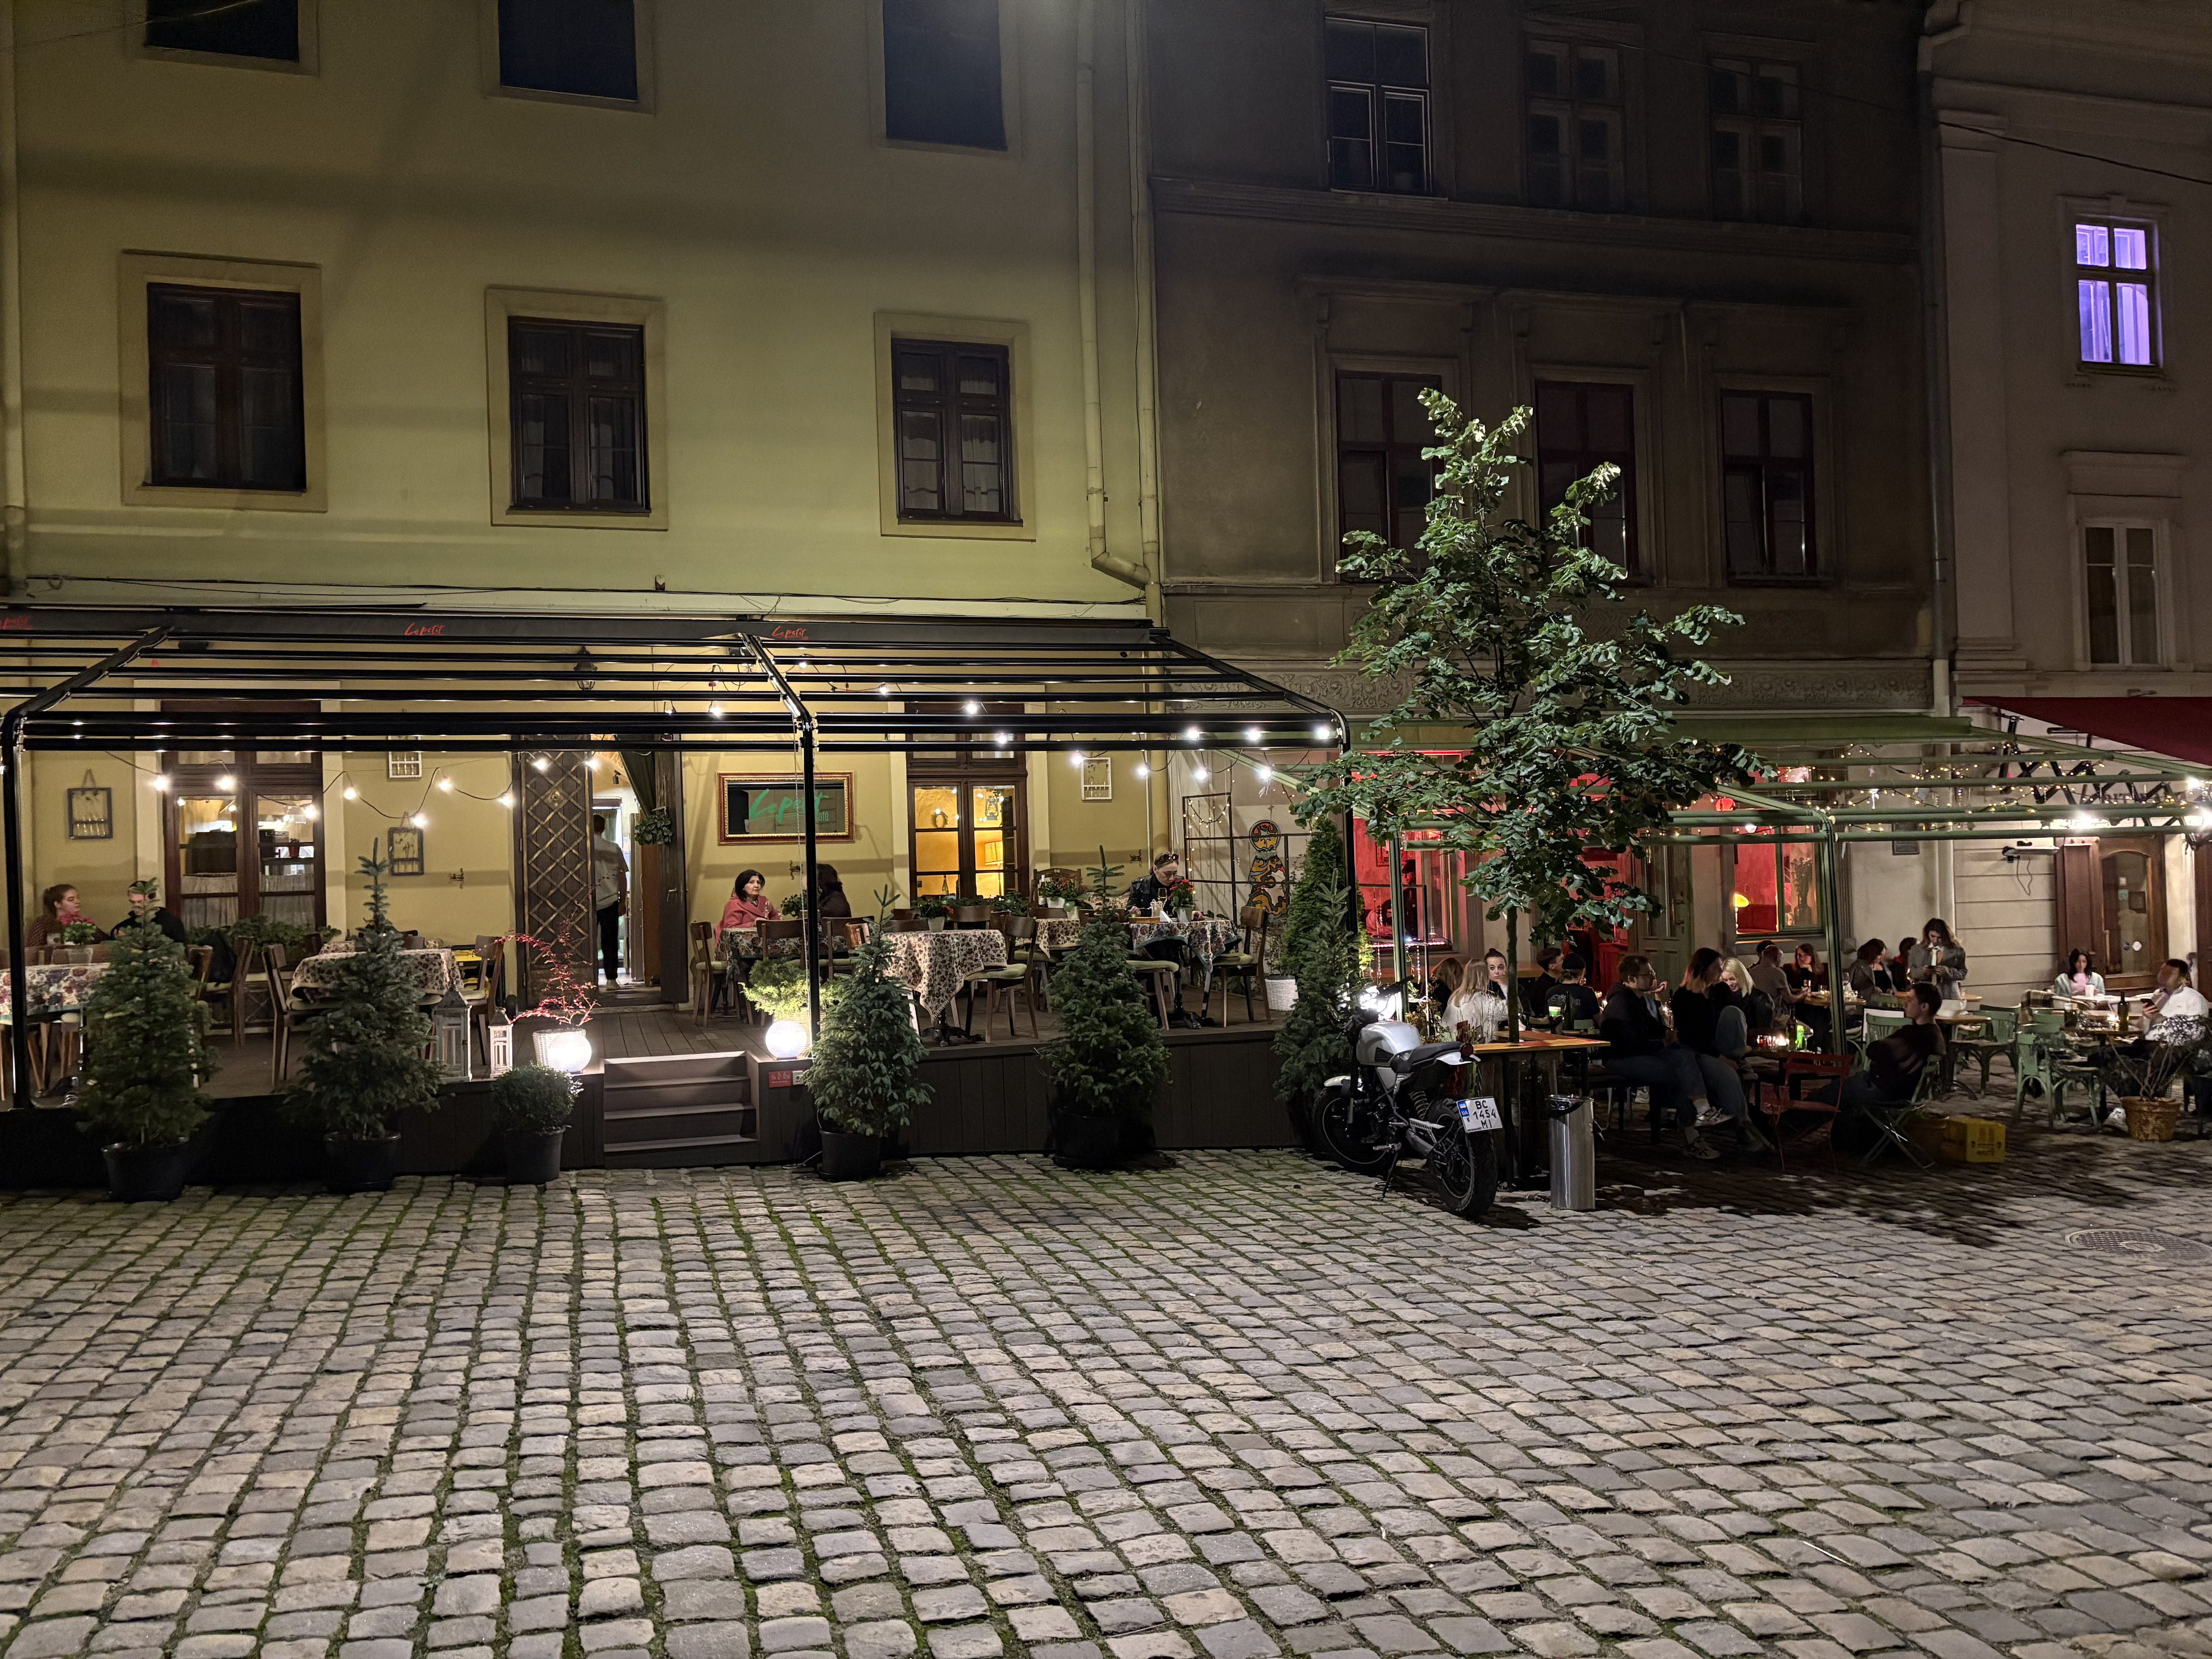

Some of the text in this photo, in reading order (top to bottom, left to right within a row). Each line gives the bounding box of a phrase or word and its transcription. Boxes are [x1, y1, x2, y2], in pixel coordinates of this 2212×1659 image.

[817, 810, 829, 822] afé
[1475, 1100, 1488, 1109] BC
[1473, 1108, 1497, 1120] 1454
[1480, 1119, 1493, 1129] MI
